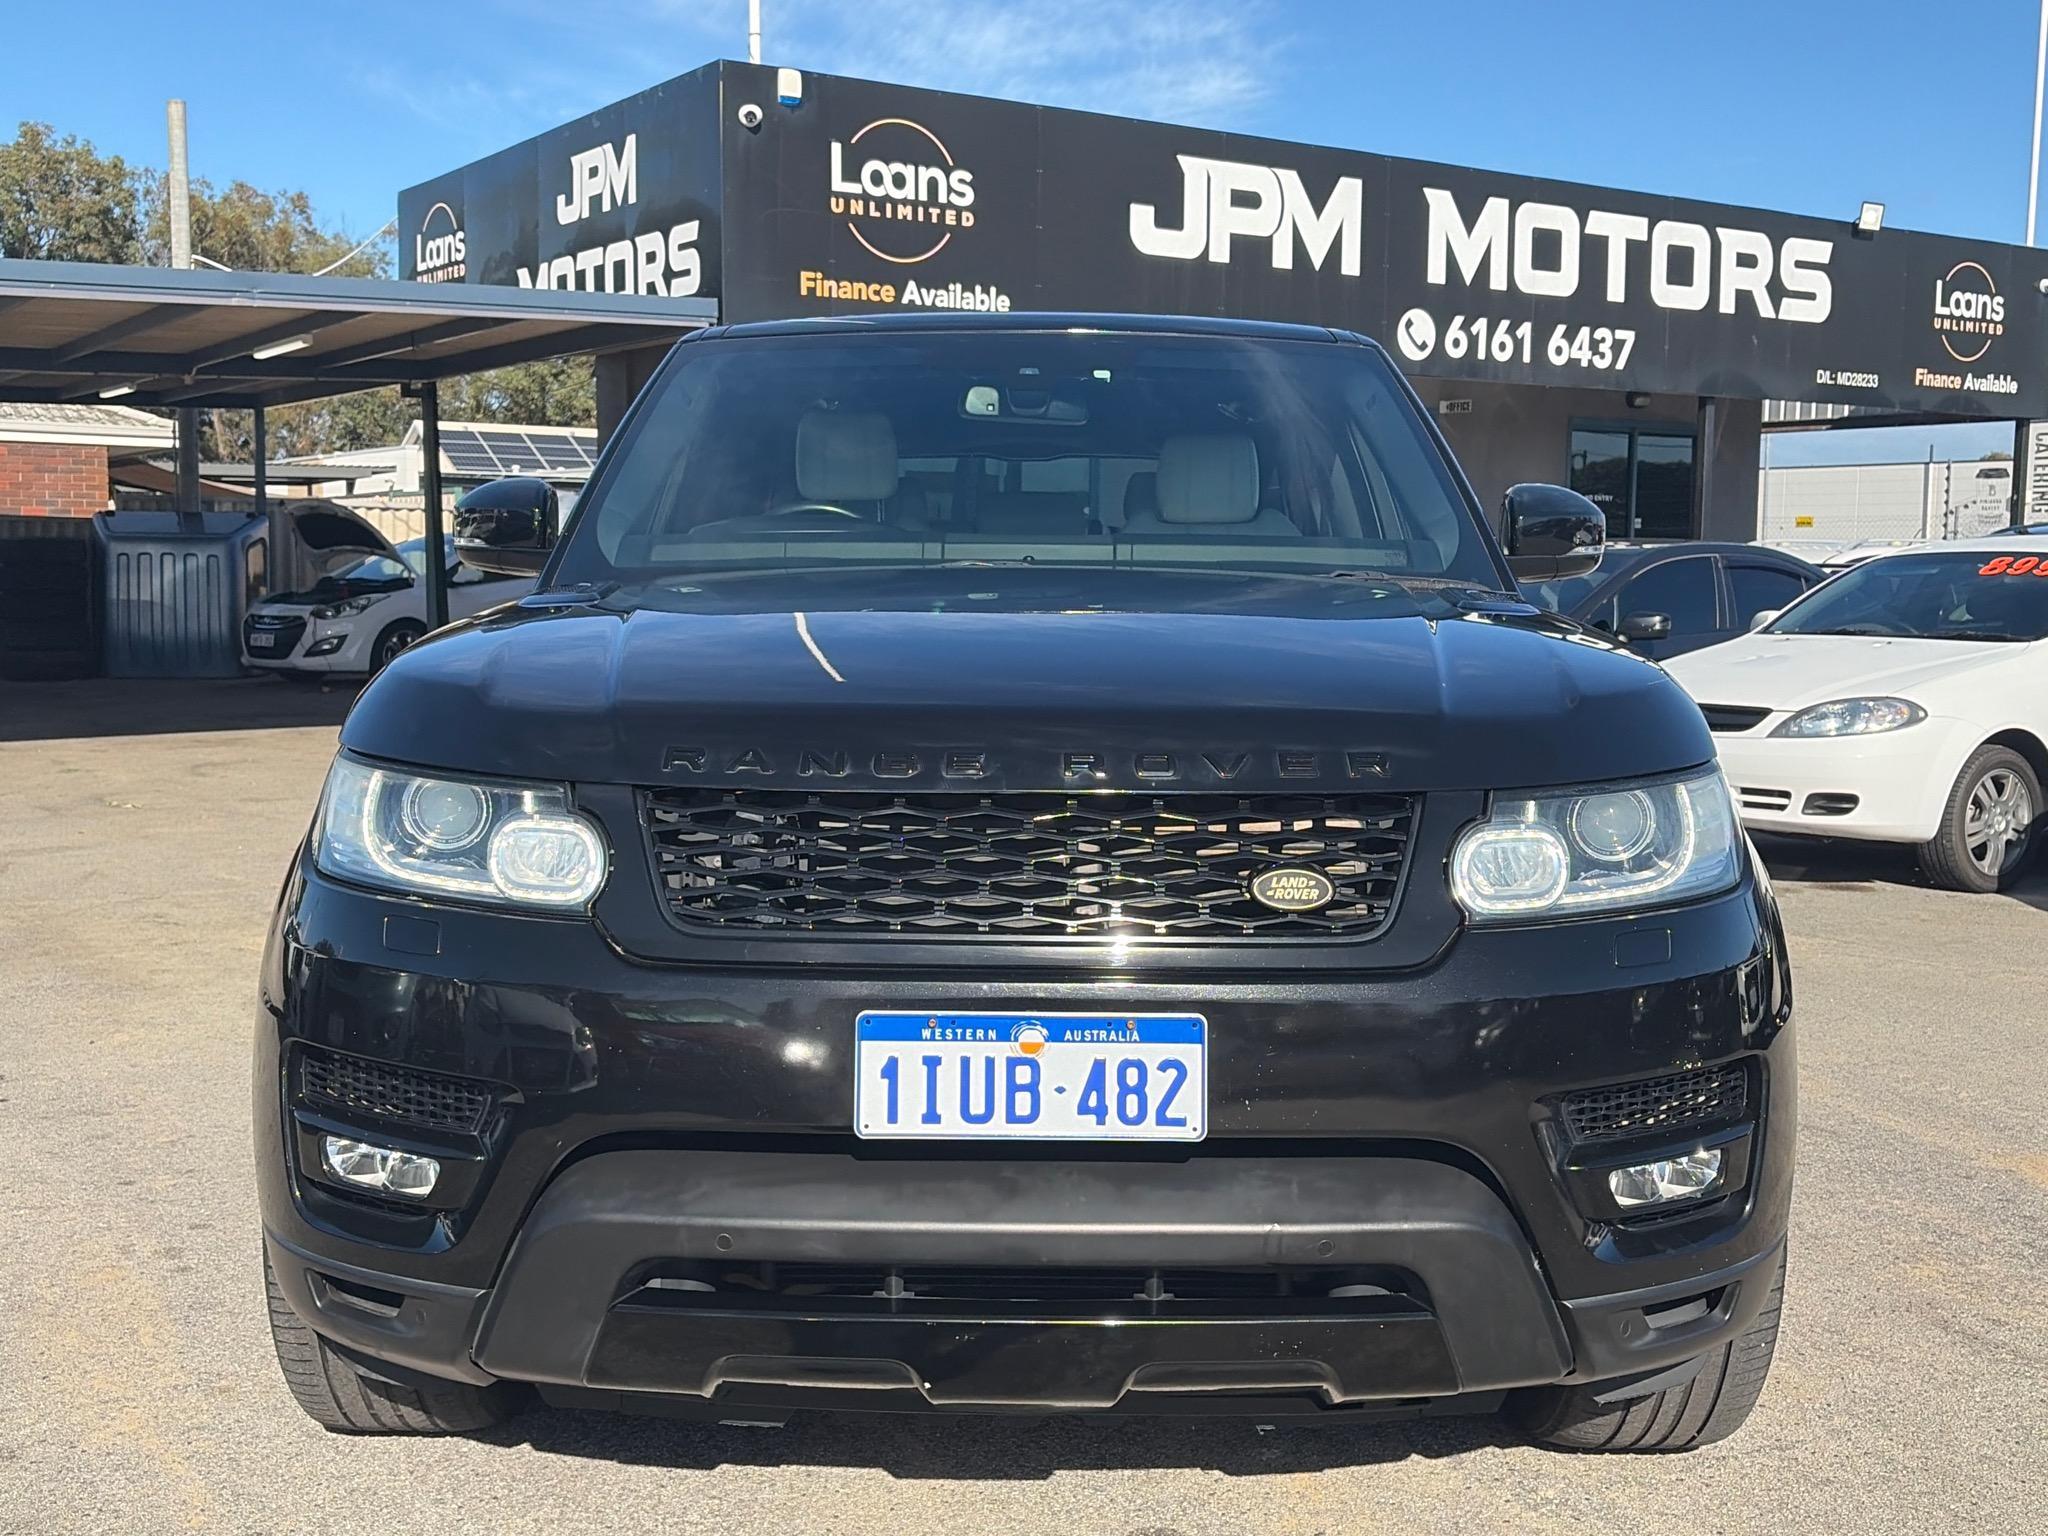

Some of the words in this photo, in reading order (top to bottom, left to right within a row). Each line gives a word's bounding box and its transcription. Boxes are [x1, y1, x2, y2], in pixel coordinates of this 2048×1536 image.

[557, 133, 637, 226] JPM
[831, 141, 975, 207] Loans
[830, 197, 975, 228] UNLIMITED
[416, 231, 466, 272] Loans
[1129, 154, 1363, 277] JPM
[1422, 187, 1834, 324] MOTORS
[800, 270, 896, 303] Finance
[901, 279, 1011, 312] Available
[1935, 279, 2005, 322] Loans
[1444, 315, 1532, 364] 6161
[1547, 324, 1636, 370] 6437
[1933, 317, 2004, 336] UNLIMITED
[1836, 371, 1879, 388] MD28233
[1915, 368, 1962, 389] Finance
[1963, 372, 2019, 394] Available
[1448, 401, 1471, 412] OFFICE
[661, 746, 985, 778] RANGE
[1063, 751, 1393, 779] ROVER
[1271, 876, 1308, 888] LAND
[1273, 888, 1320, 900] ROVER
[921, 1028, 997, 1041] WESTERN
[1063, 1029, 1141, 1042] AUSTRALIA
